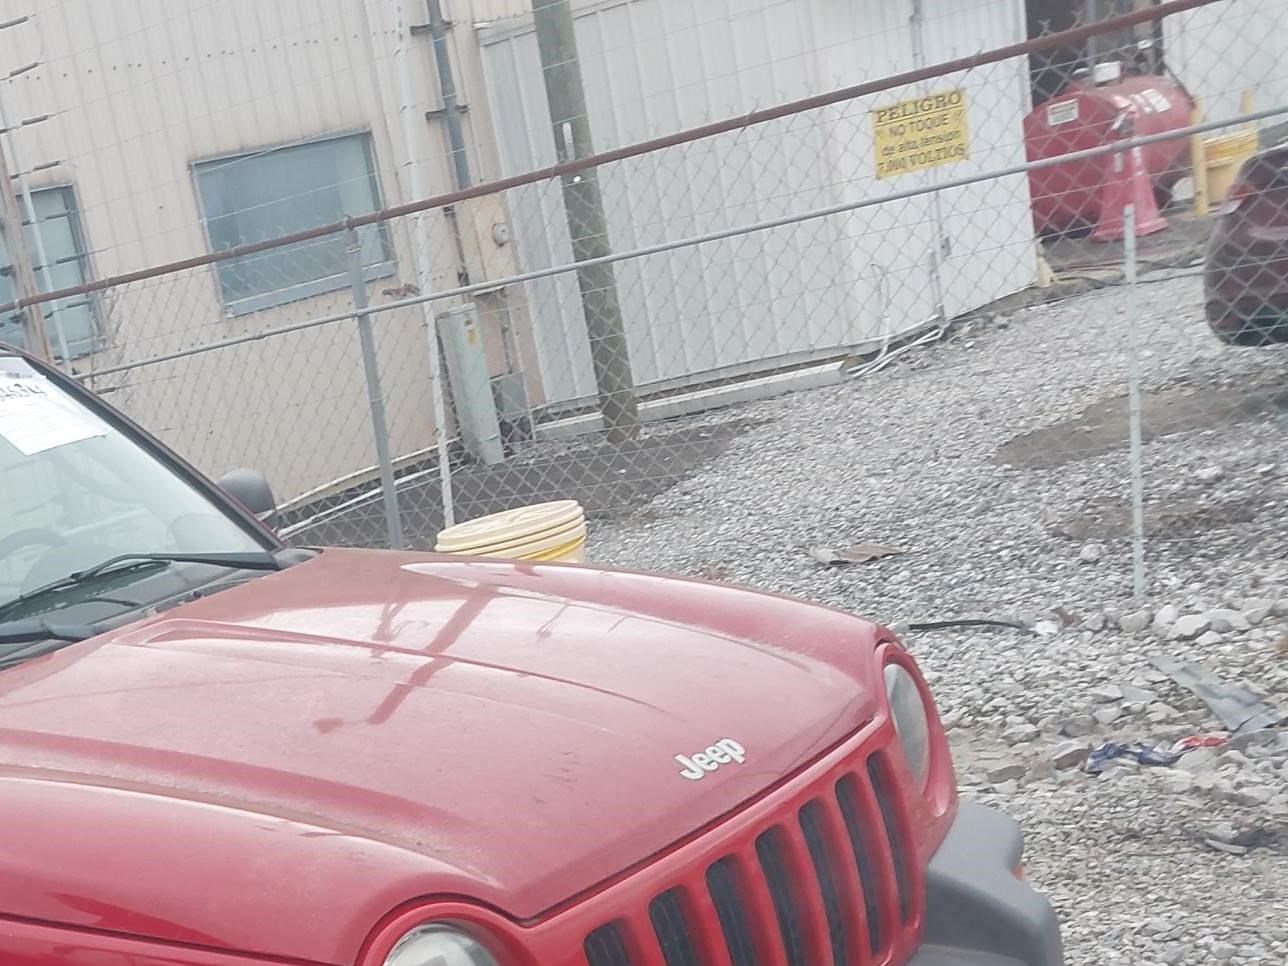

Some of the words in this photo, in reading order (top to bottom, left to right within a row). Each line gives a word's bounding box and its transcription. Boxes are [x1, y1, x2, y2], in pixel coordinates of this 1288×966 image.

[877, 91, 962, 123] PELIGRO
[889, 123, 905, 136] NO
[910, 113, 950, 133] TOQUE
[909, 143, 966, 166] VOLTIOS
[673, 738, 746, 780] Jeep
